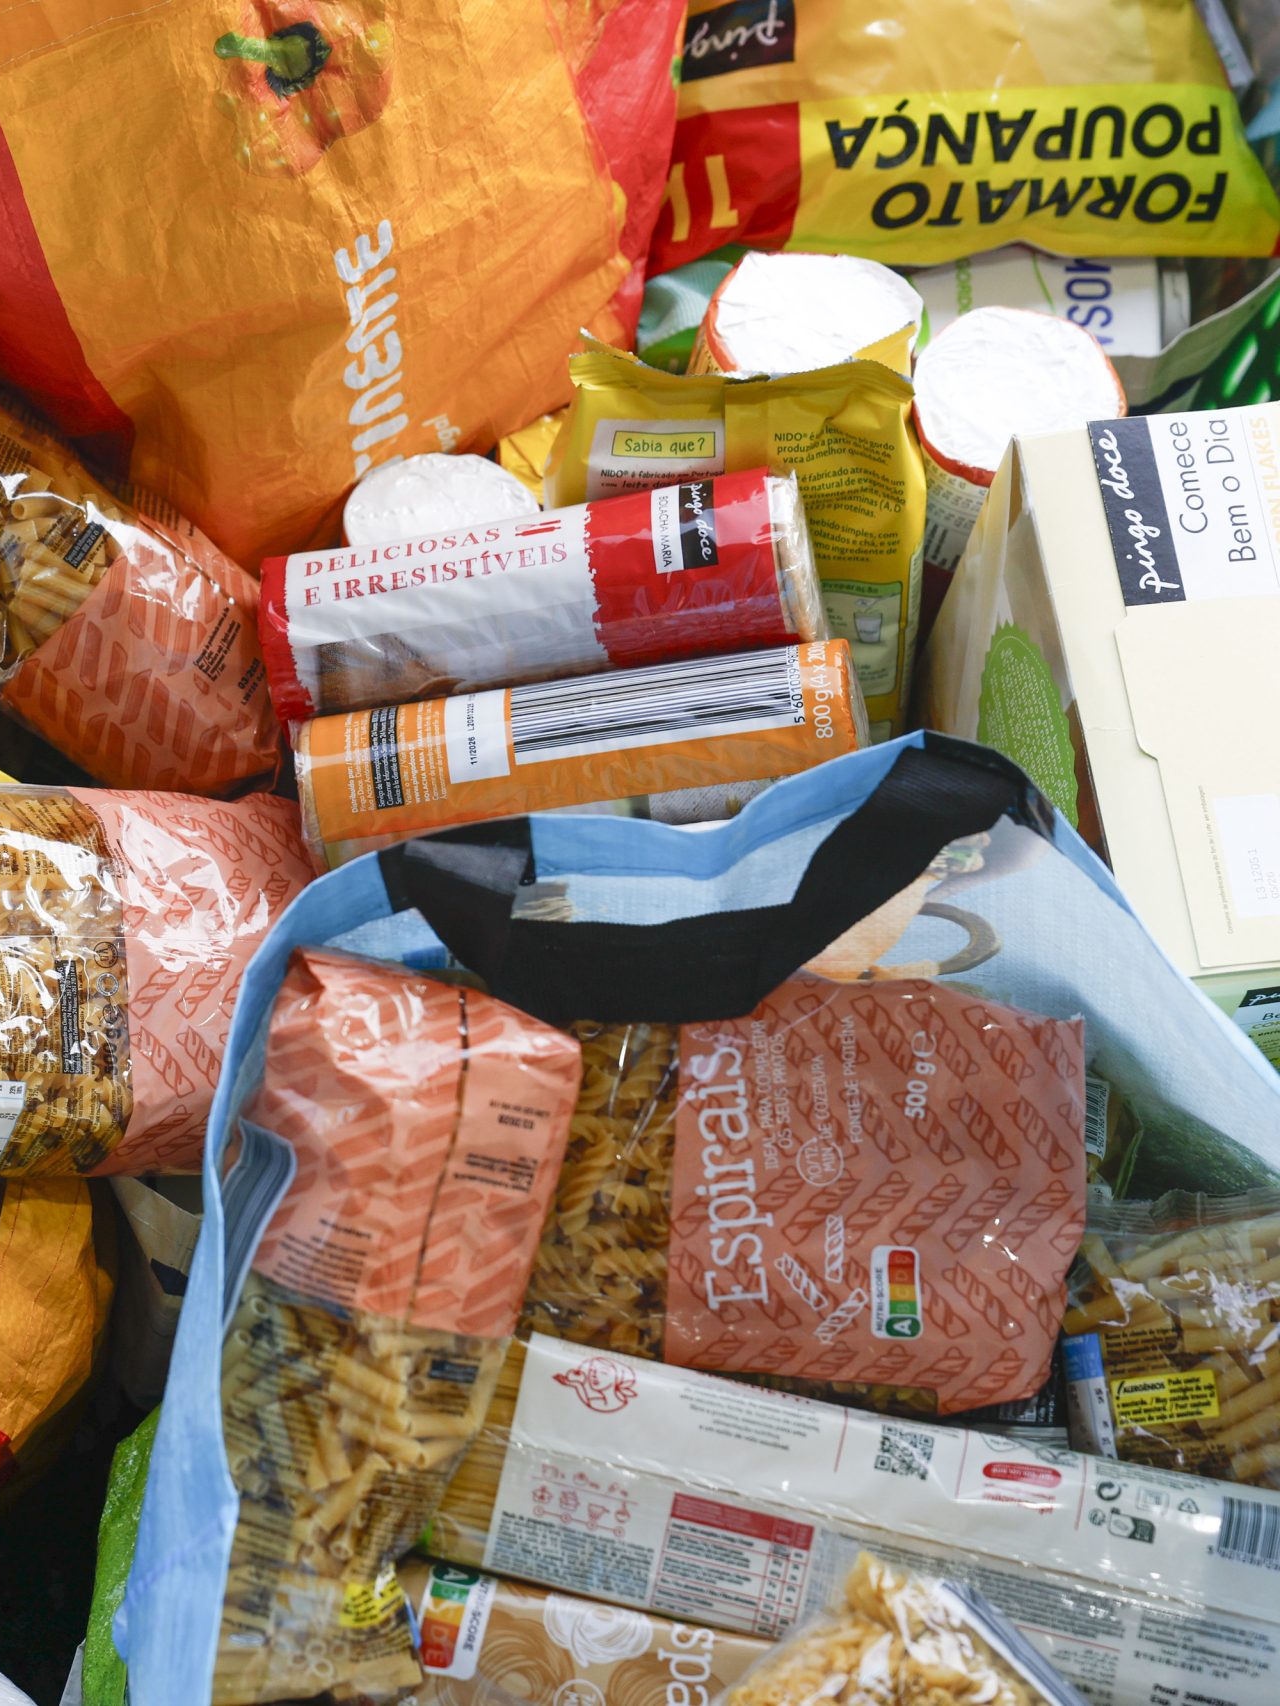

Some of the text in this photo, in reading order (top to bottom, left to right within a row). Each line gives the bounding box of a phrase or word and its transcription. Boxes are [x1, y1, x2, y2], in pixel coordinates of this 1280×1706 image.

[824, 98, 1221, 171] POUPANÇA
[871, 171, 1228, 230] FORMATO
[624, 437, 663, 452] Sabia
[1168, 419, 1208, 534] Comece
[681, 482, 716, 561] pingo doce
[1099, 429, 1178, 593] pingo doce
[1201, 417, 1256, 563] Bem o Dia
[304, 526, 500, 577] DELICIOSAS
[656, 496, 673, 568] BOLACHA MARIA
[305, 540, 568, 606] E IRRESISTÍVEIS
[464, 735, 480, 765] 11/2026
[810, 703, 835, 739] 800
[751, 1020, 780, 1168] IDEAL PARA COMPLETAR
[772, 1086, 791, 1124] SEUS
[807, 1054, 834, 1138] DE COZEDURA
[835, 1015, 865, 1142] FONTE DE PROTEÍNA
[903, 1061, 936, 1119] 500 g
[776, 1127, 794, 1149] OS
[686, 1045, 773, 1310] Espirais
[892, 1317, 912, 1335] A
[658, 1625, 714, 1706] spa
